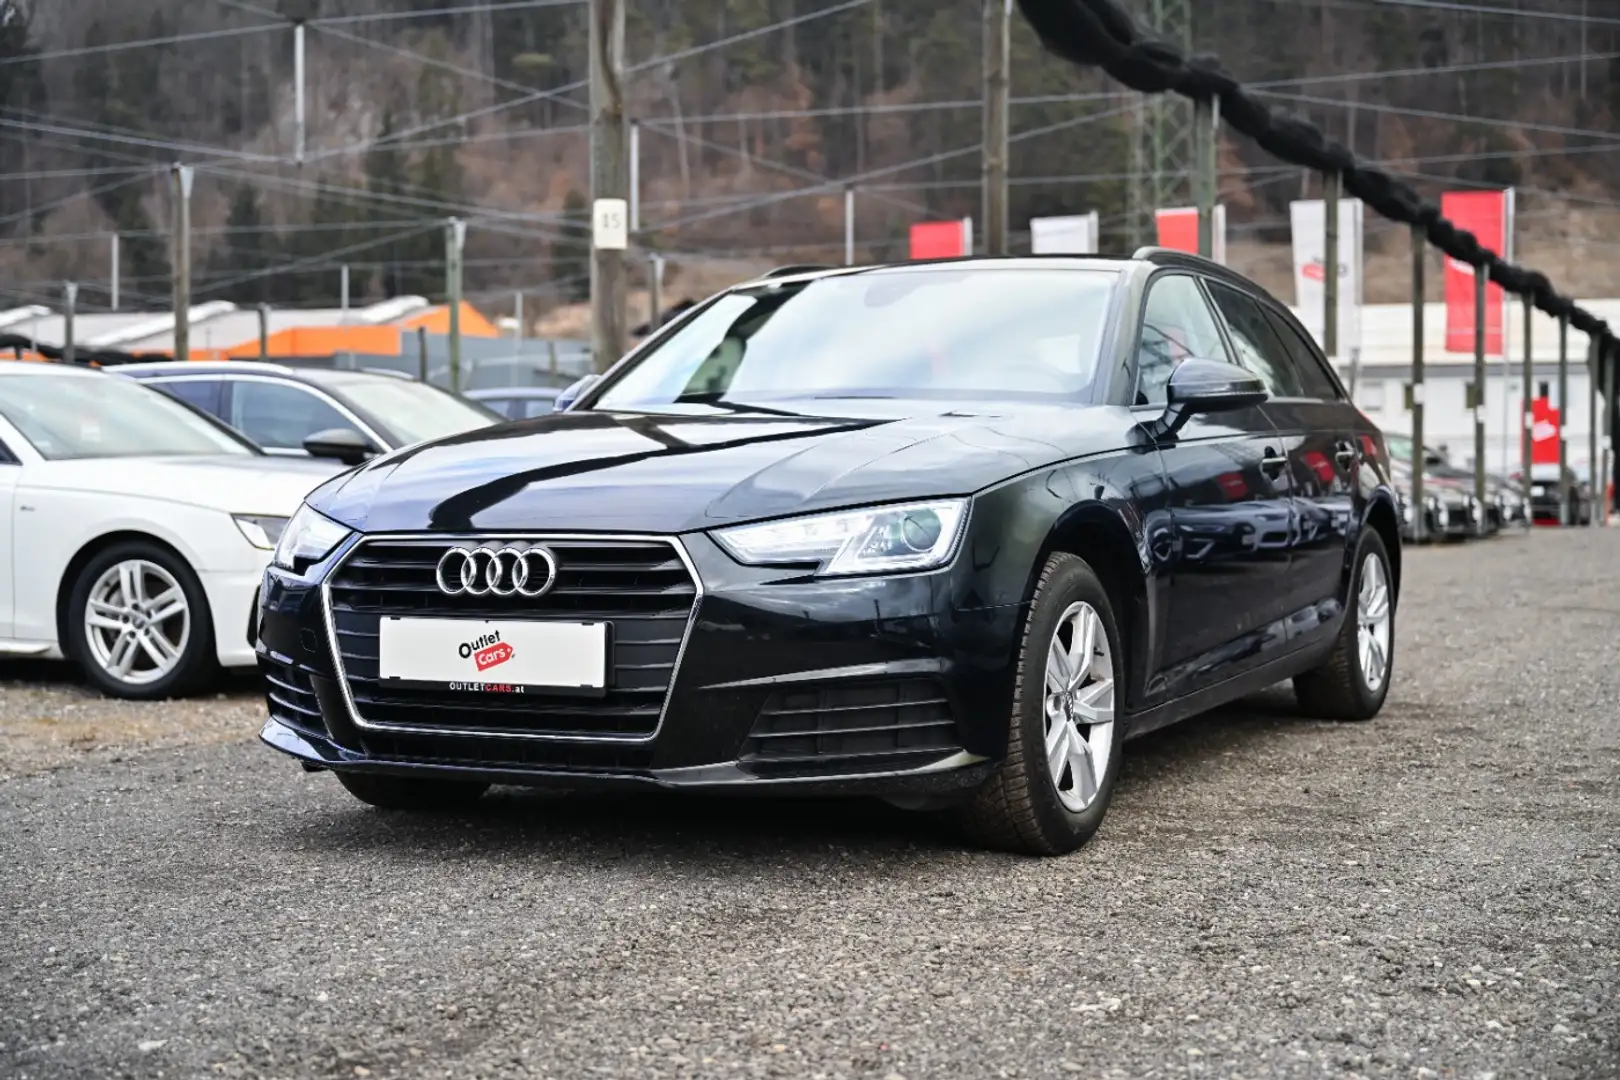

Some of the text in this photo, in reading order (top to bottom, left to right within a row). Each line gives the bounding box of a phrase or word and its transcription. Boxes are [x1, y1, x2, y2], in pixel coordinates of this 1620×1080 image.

[602, 212, 621, 229] 15
[459, 630, 500, 659] Outlet
[478, 648, 506, 666] Cars
[449, 681, 524, 694] OUTLETCARS.at
